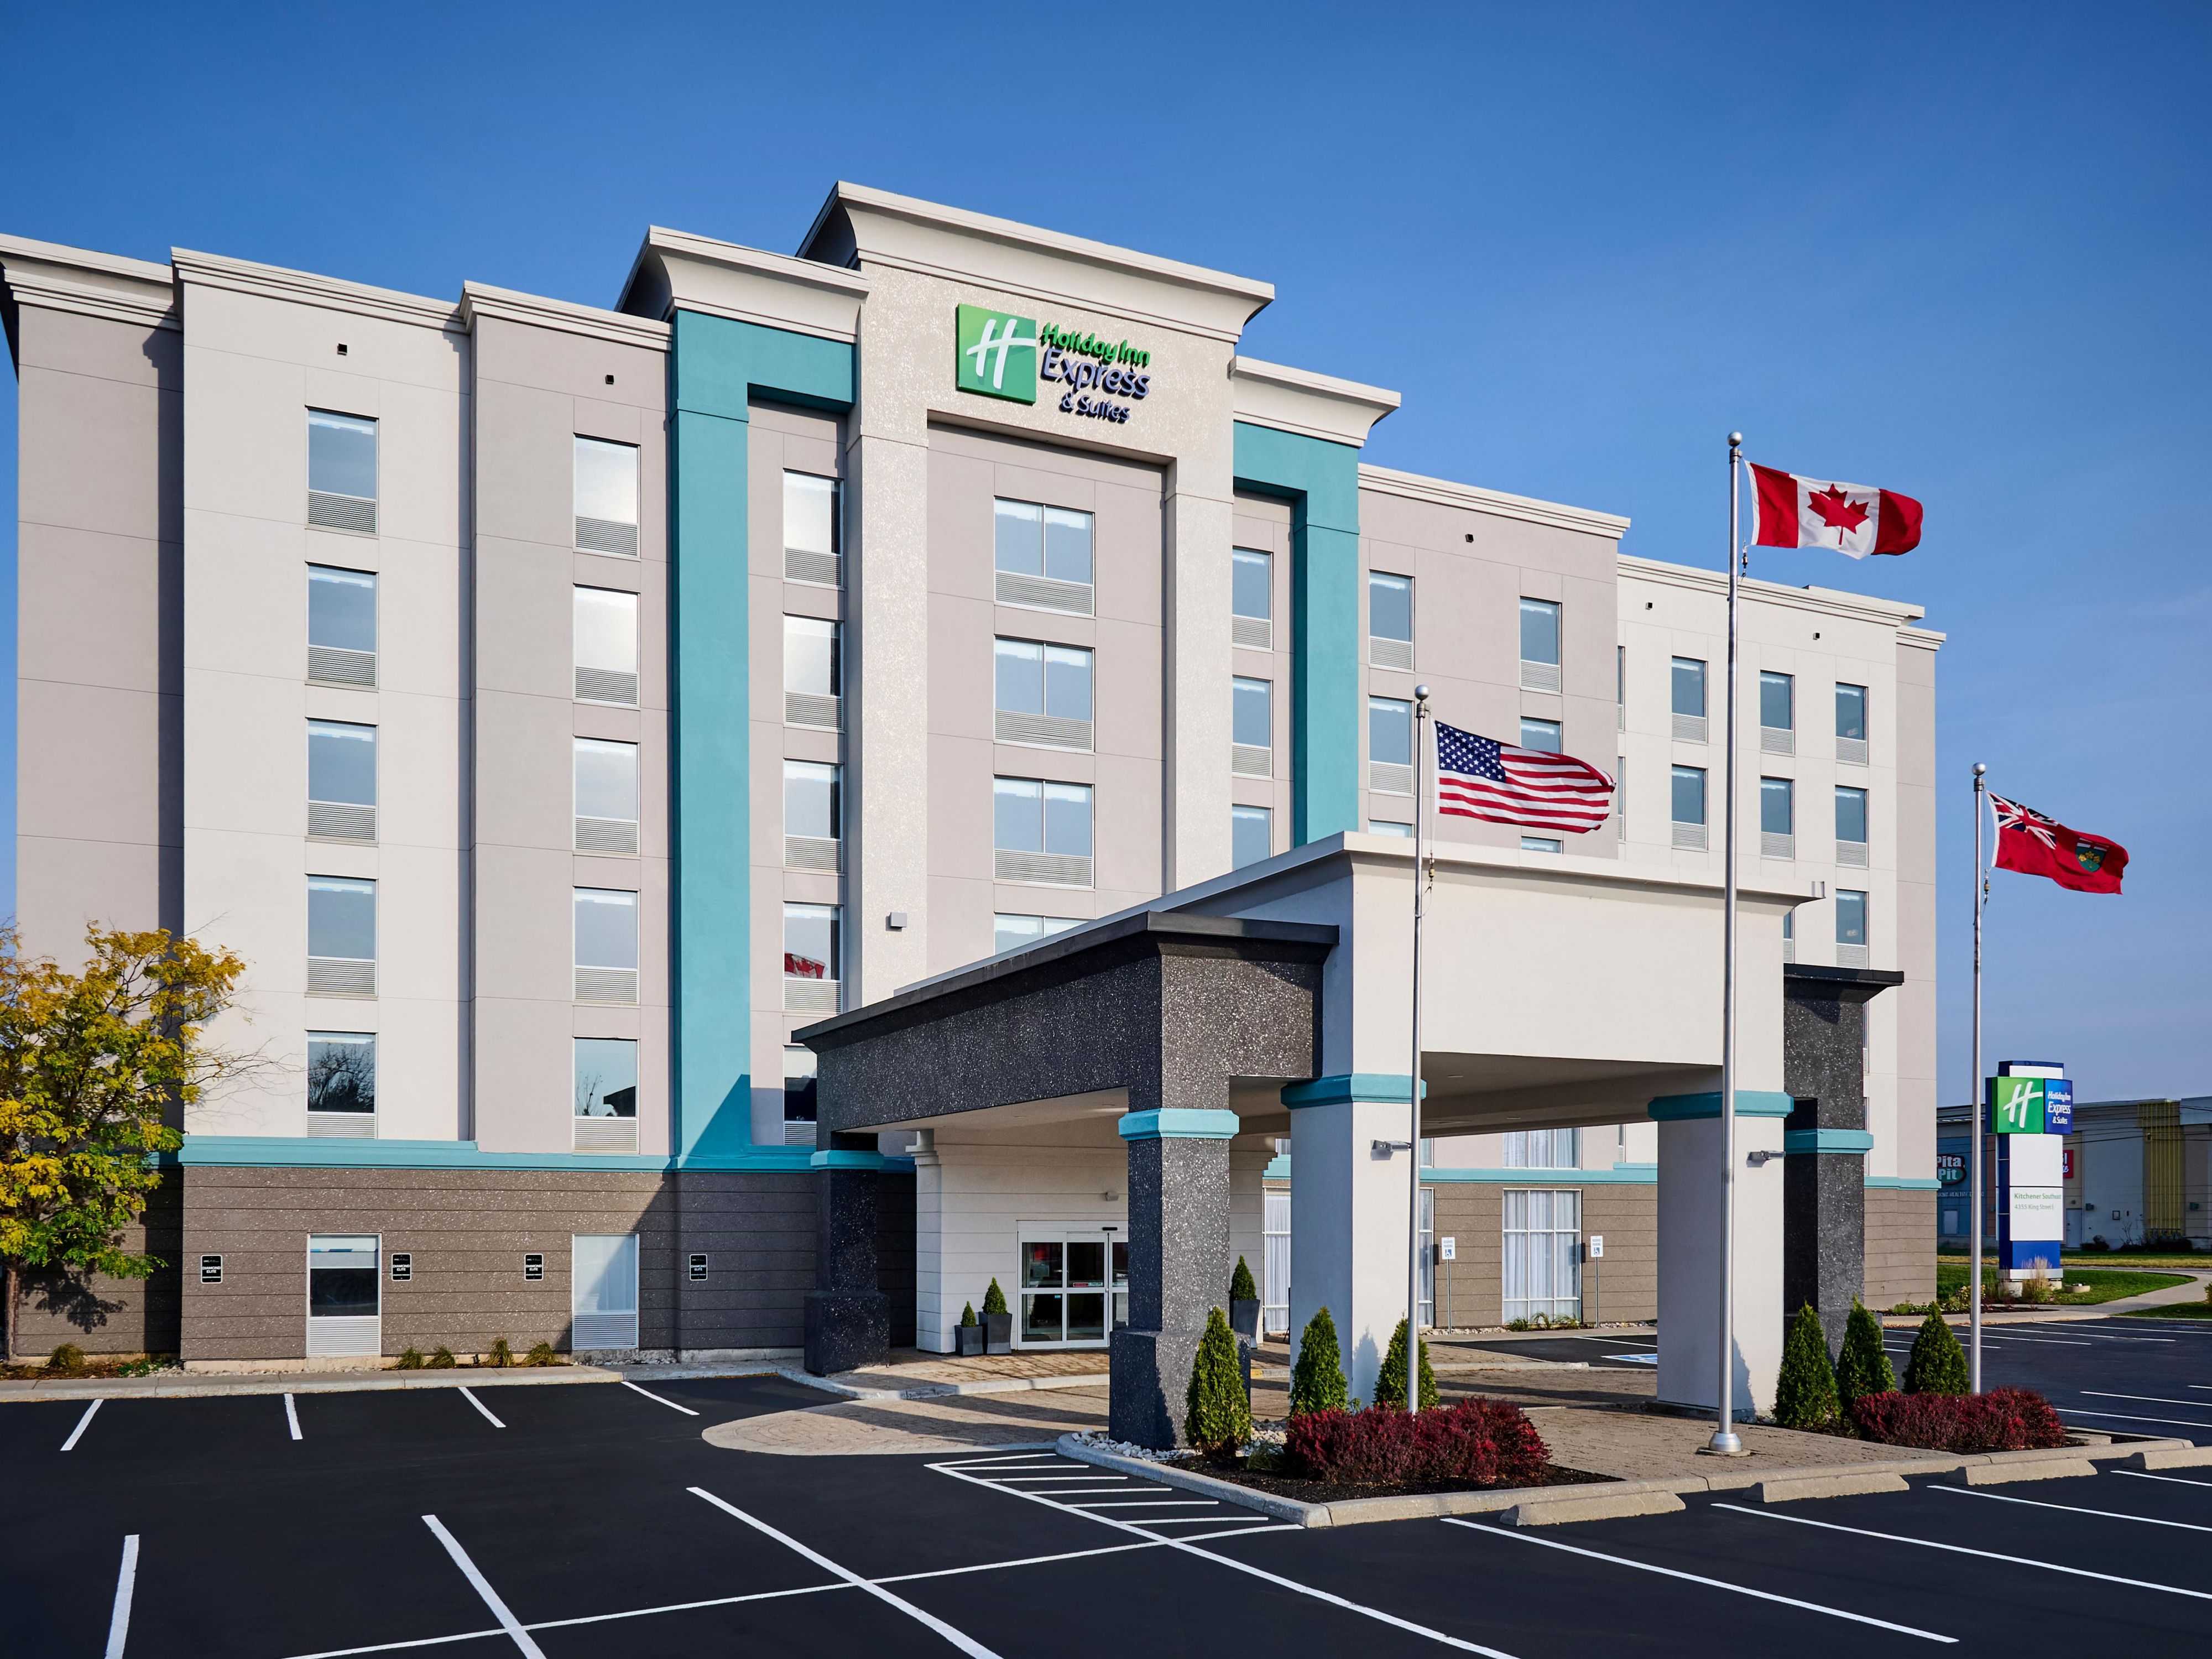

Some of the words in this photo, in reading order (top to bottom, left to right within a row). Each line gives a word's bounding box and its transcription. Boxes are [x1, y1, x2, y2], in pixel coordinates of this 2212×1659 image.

[1042, 322, 1118, 363] Holiday
[1119, 339, 1151, 366] Inn
[1042, 348, 1151, 398] Express
[1061, 392, 1074, 413] &
[1077, 394, 1131, 421] Suites
[2048, 1091, 2065, 1102] Holiday
[2047, 1101, 2071, 1116] Express
[2057, 1116, 2068, 1125] Suites
[1938, 1168, 1957, 1180] Pit
